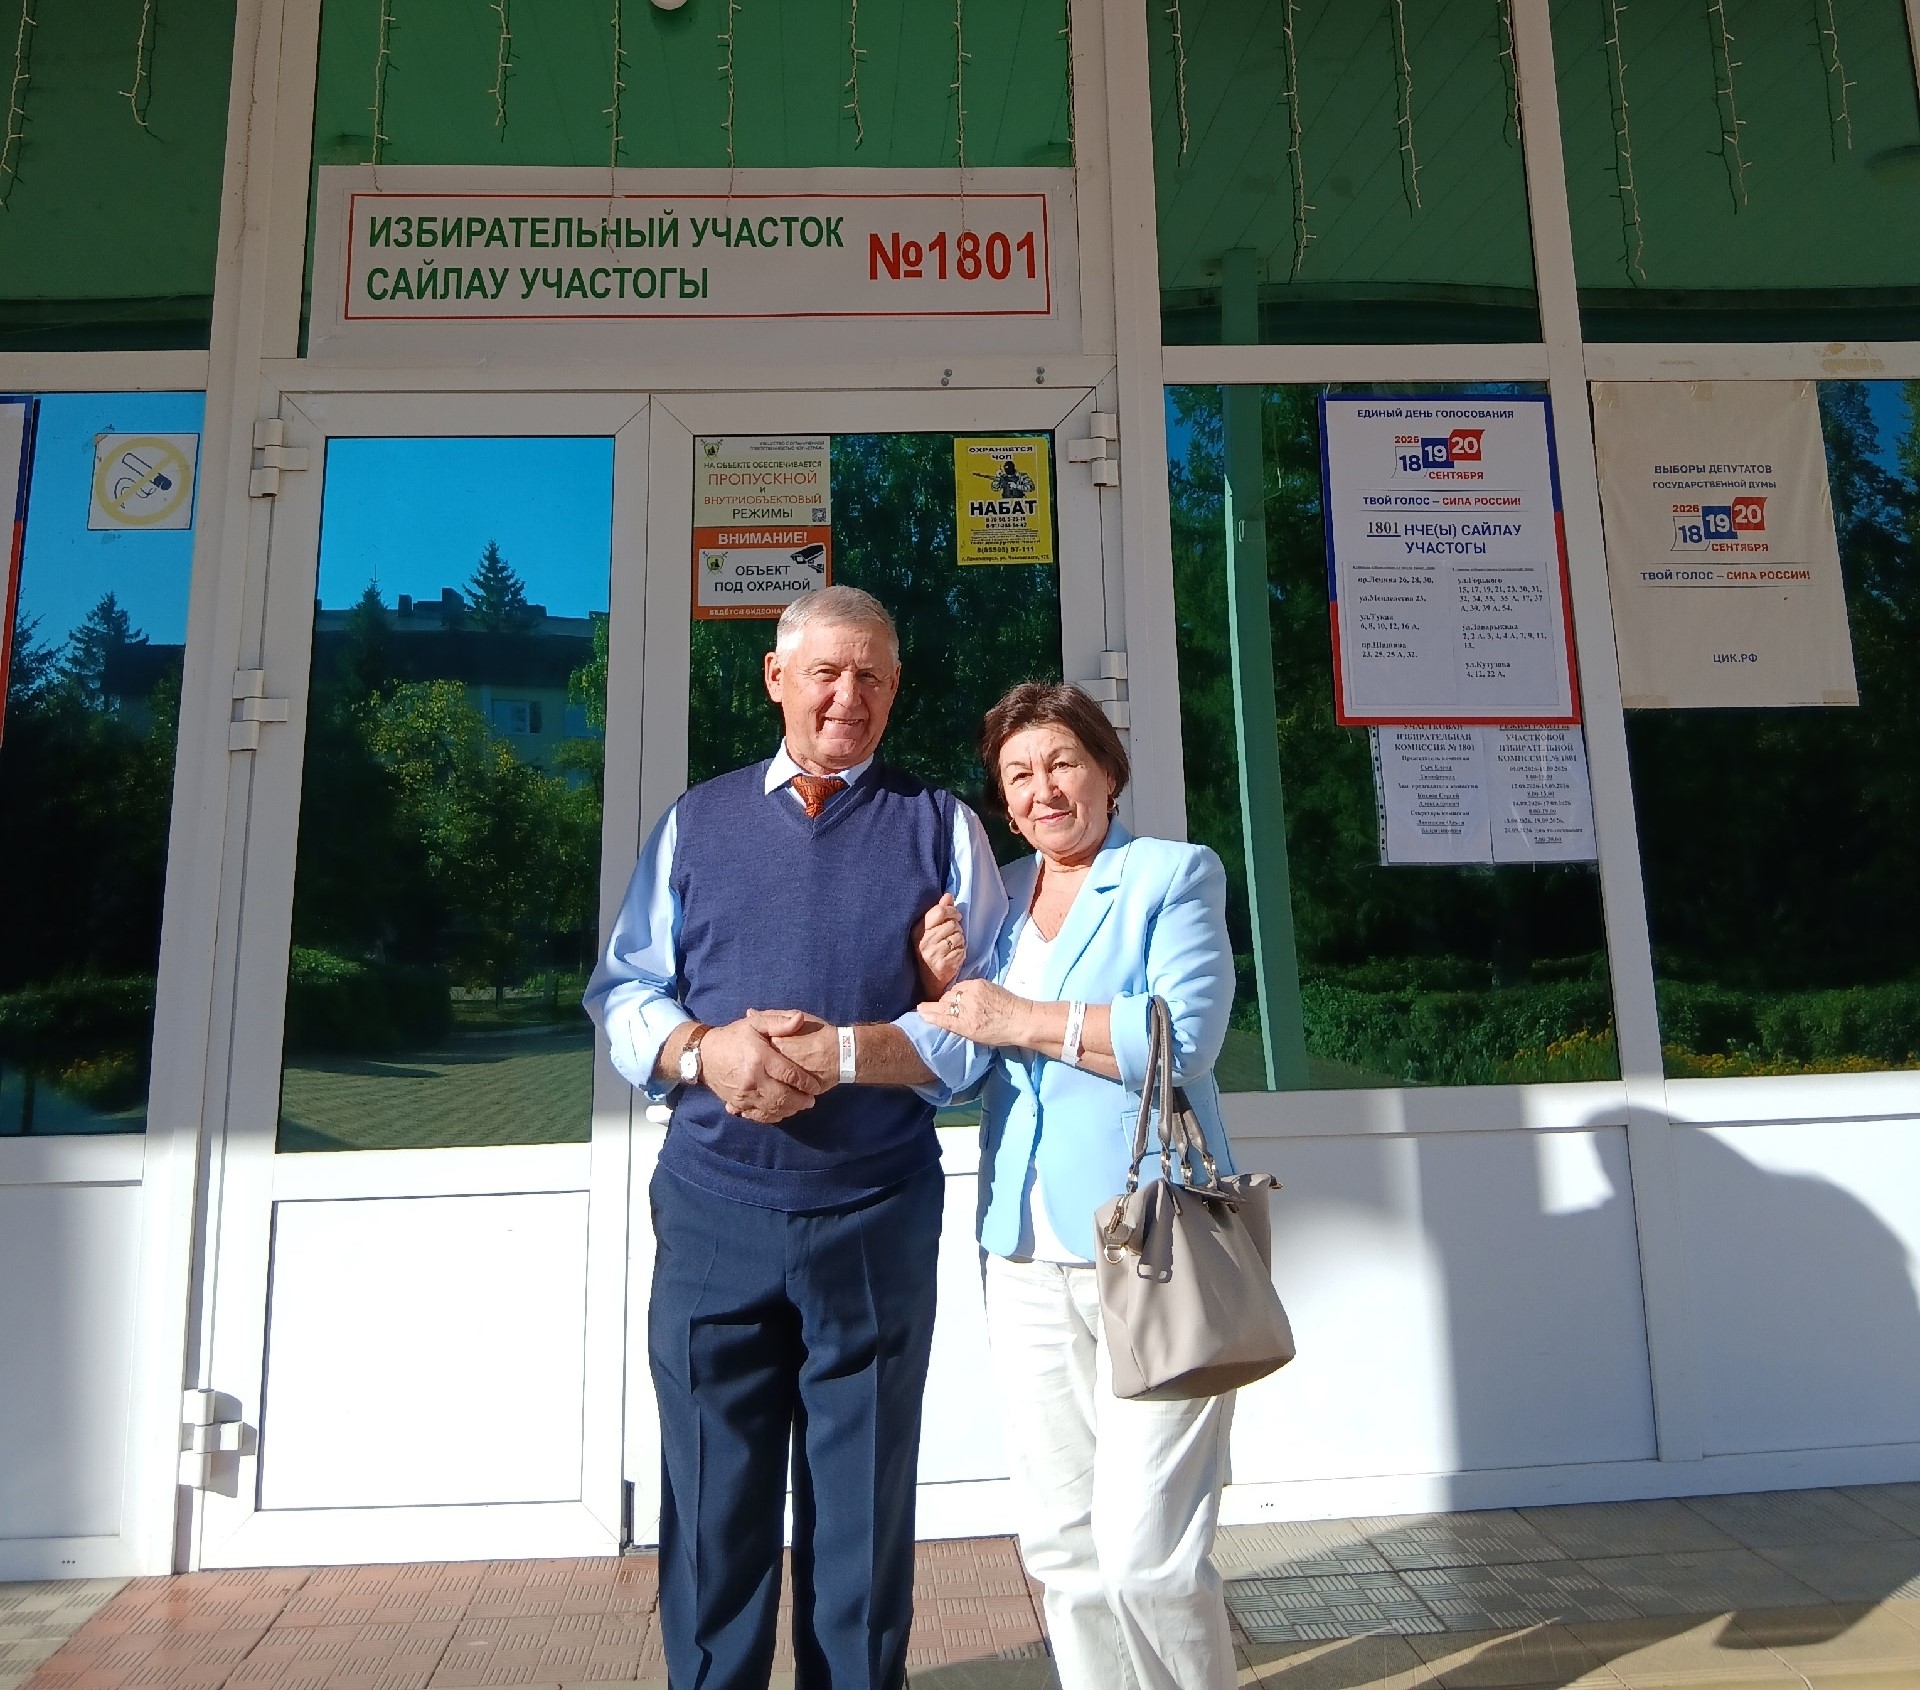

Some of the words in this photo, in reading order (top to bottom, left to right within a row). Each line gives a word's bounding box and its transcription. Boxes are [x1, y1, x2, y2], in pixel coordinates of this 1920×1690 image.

[369, 209, 679, 248] ИЗБИРАТЕЛЬНЫЙ
[690, 216, 844, 248] УЧАСТОК
[869, 231, 1037, 280] №1801
[367, 259, 510, 301] САЙЛАУ
[520, 267, 708, 300] УЧАСТОГЫ
[1358, 408, 1402, 419] ЕДИНЫЙ
[1405, 410, 1432, 419] ДЕНЬ
[1436, 410, 1514, 418] ГОЛОСОВАНИЯ
[1452, 437, 1478, 454] 20
[1425, 446, 1447, 462] 19
[1399, 455, 1421, 471] 18
[1655, 465, 1705, 474] ВЫБОРЫ
[1709, 465, 1772, 474] ДЕПУТАТОВ
[708, 470, 817, 485] ПРОПУСКНОЙ
[1429, 471, 1484, 480] СЕНТЯБРЯ
[1653, 479, 1746, 489] ГОСУДАРСТВЕННОЙ
[704, 493, 822, 504] ВНУТРИОБЪЕКТОВЫЙ
[1363, 495, 1392, 505] ТВОЙ
[1394, 497, 1430, 505] ГОЛОС
[1443, 497, 1471, 506] СИЛА
[1474, 497, 1521, 506] РОССИИ!
[732, 509, 792, 519] РЕЖИМЫ
[970, 500, 1037, 515] НАБАТ
[1734, 505, 1762, 523] 20
[1367, 522, 1400, 534] 1801
[1404, 524, 1457, 538] НЧЕ(Ы)
[1461, 522, 1522, 536] САЙЛАУ
[1706, 514, 1730, 532] 19
[718, 532, 807, 544] ВНИМАНИЕ!
[1678, 525, 1702, 543] 18
[1405, 542, 1486, 554] УЧАСТОГЫ
[735, 566, 790, 575] ОБЪЕКТ
[1640, 569, 1672, 580] ТВОЙ
[1676, 571, 1713, 580] ГОЛОС
[1727, 571, 1757, 580] СИЛА
[1760, 571, 1810, 580] РОССИИ!
[714, 582, 743, 593] ПОД
[747, 578, 810, 591] ОХРАНОЙ
[1713, 653, 1758, 664] ЦИК.РФ
